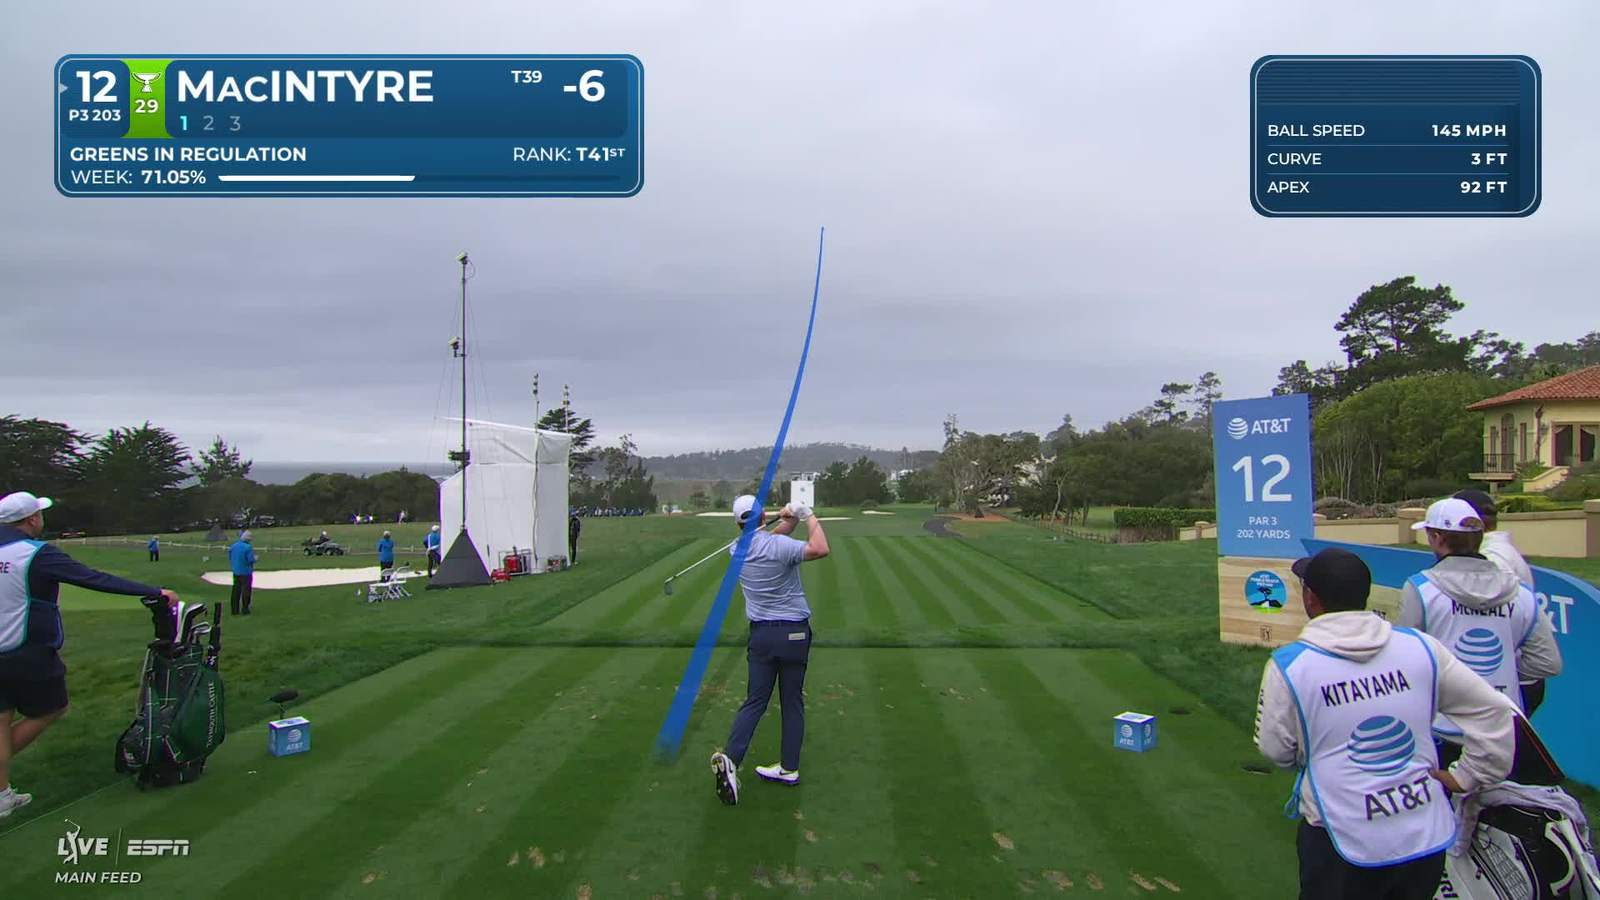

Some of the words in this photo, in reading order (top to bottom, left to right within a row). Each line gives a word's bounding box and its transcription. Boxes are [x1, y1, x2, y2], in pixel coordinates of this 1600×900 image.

[1251, 418, 1291, 434] AT&T
[1232, 454, 1292, 502] 12
[1248, 516, 1268, 525] PAR
[1270, 516, 1277, 525] 3
[1237, 529, 1255, 538] 202
[1256, 529, 1291, 539] YARDS
[1321, 670, 1411, 707] KITAYAMA
[1365, 776, 1432, 821] AT&T
